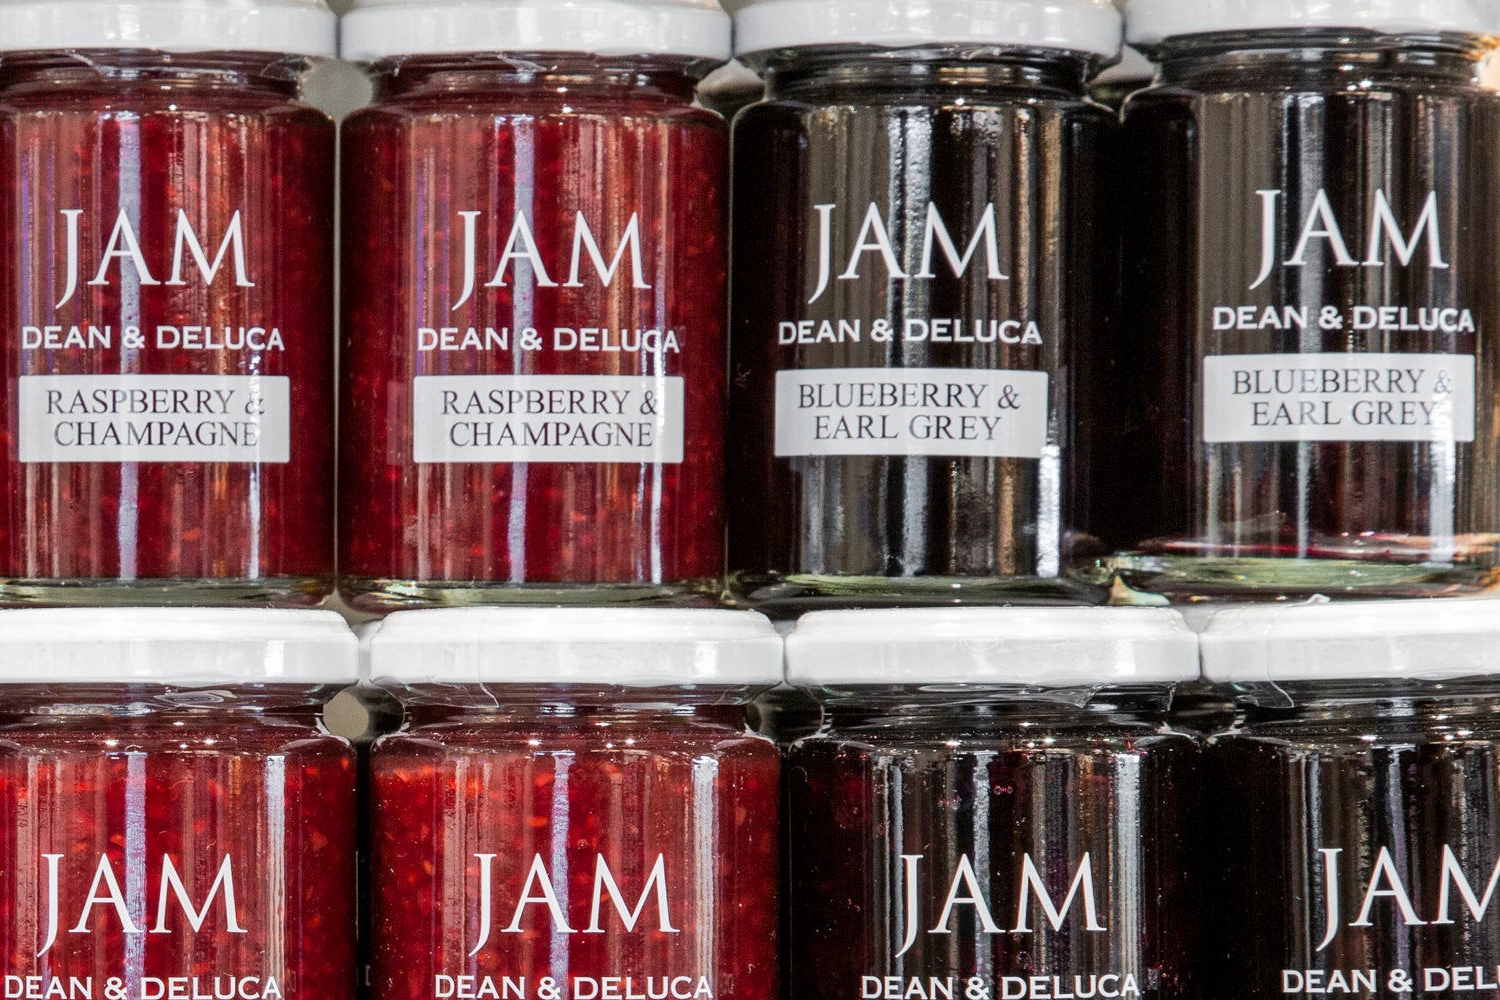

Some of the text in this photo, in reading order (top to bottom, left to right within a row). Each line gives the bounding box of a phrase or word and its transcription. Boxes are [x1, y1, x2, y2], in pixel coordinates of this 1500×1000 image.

[1249, 188, 1449, 290] JAM
[55, 207, 255, 309] JAM
[452, 210, 651, 310] JAM
[808, 201, 1009, 304] JAM
[779, 318, 1043, 345] DEAN & DELUCA
[1213, 306, 1475, 332] DEAN & DELUCA
[22, 325, 285, 351] DEAN & DELUCA
[418, 328, 680, 353] DEAN & DELUCA
[1233, 369, 1452, 395] BLUEBERRY &
[46, 389, 235, 415] RASPBERRY
[441, 389, 658, 416] RASPBERRY &
[798, 383, 1021, 409] BLUEBERRY &
[1251, 401, 1437, 426] EARL GREY
[55, 422, 259, 447] CHAMPAGNE
[450, 422, 653, 447] CHAMPAGNE
[813, 415, 1002, 440] EARL GREY
[37, 853, 248, 957] JAM
[469, 853, 680, 957] JAM
[895, 852, 1107, 958] JAM
[5, 975, 282, 1000] DEAN & DELUCA
[435, 975, 713, 1000] DEAN & DELUCA
[862, 974, 1140, 999] DEAN & DELUCA
[1282, 970, 1376, 993] DEAN
[1388, 968, 1413, 992] &
